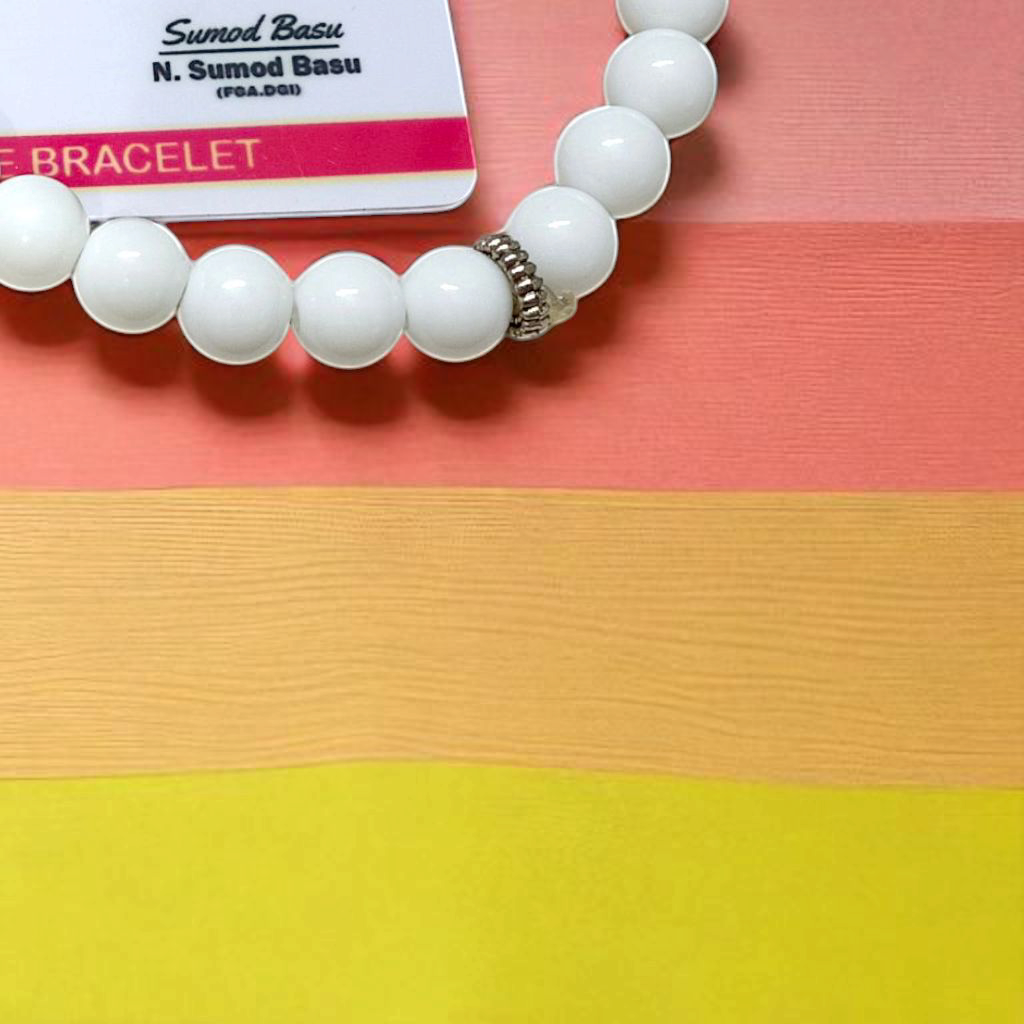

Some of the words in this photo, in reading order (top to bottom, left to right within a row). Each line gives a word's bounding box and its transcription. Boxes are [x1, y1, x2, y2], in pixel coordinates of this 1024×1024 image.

[162, 14, 266, 46] Sumod
[270, 13, 345, 41] Basu
[152, 61, 182, 83] N.
[187, 56, 285, 81] Sumod
[291, 54, 362, 77] Basu
[31, 137, 262, 178] BRACELET
